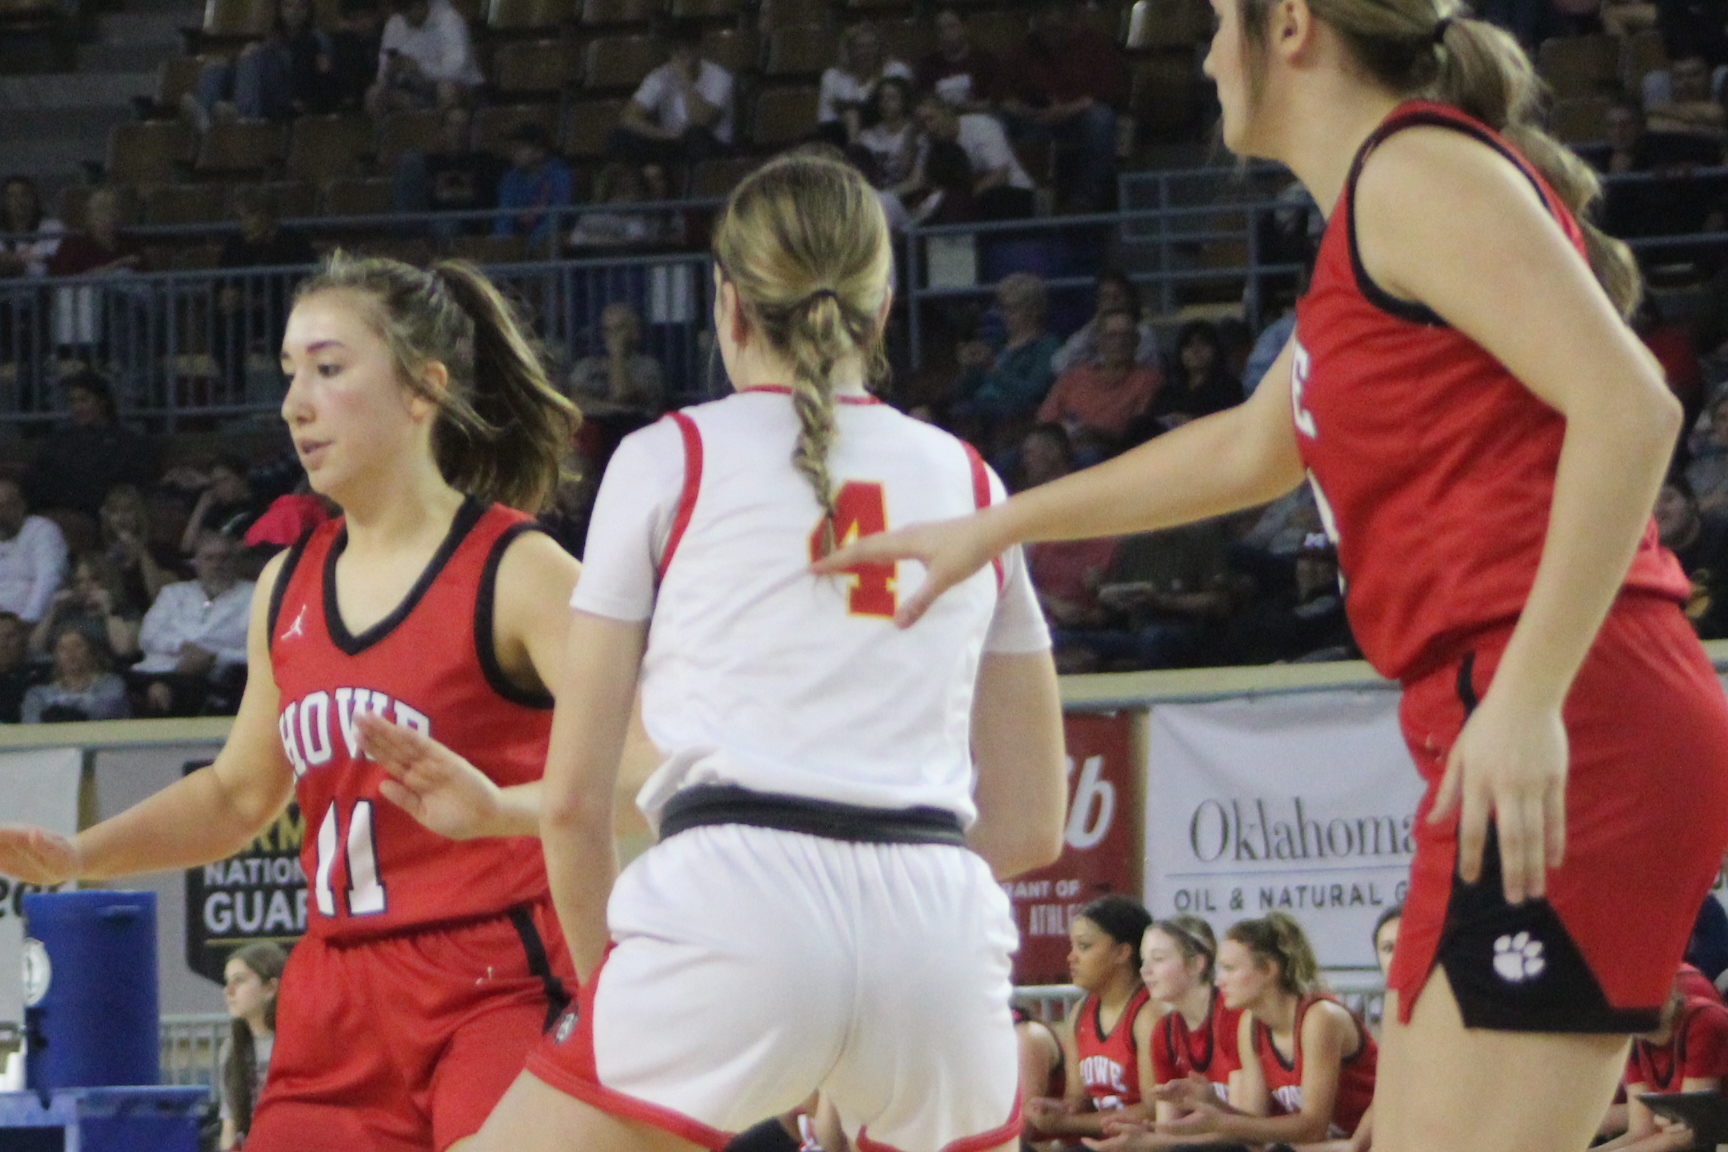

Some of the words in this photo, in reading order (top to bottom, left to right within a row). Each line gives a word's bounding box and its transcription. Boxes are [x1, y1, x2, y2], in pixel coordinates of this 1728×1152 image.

[808, 479, 900, 620] 4
[315, 799, 389, 916] 11
[1175, 888, 1216, 912] OIL
[1230, 889, 1244, 911] &
[1258, 883, 1383, 911] NATURAL
